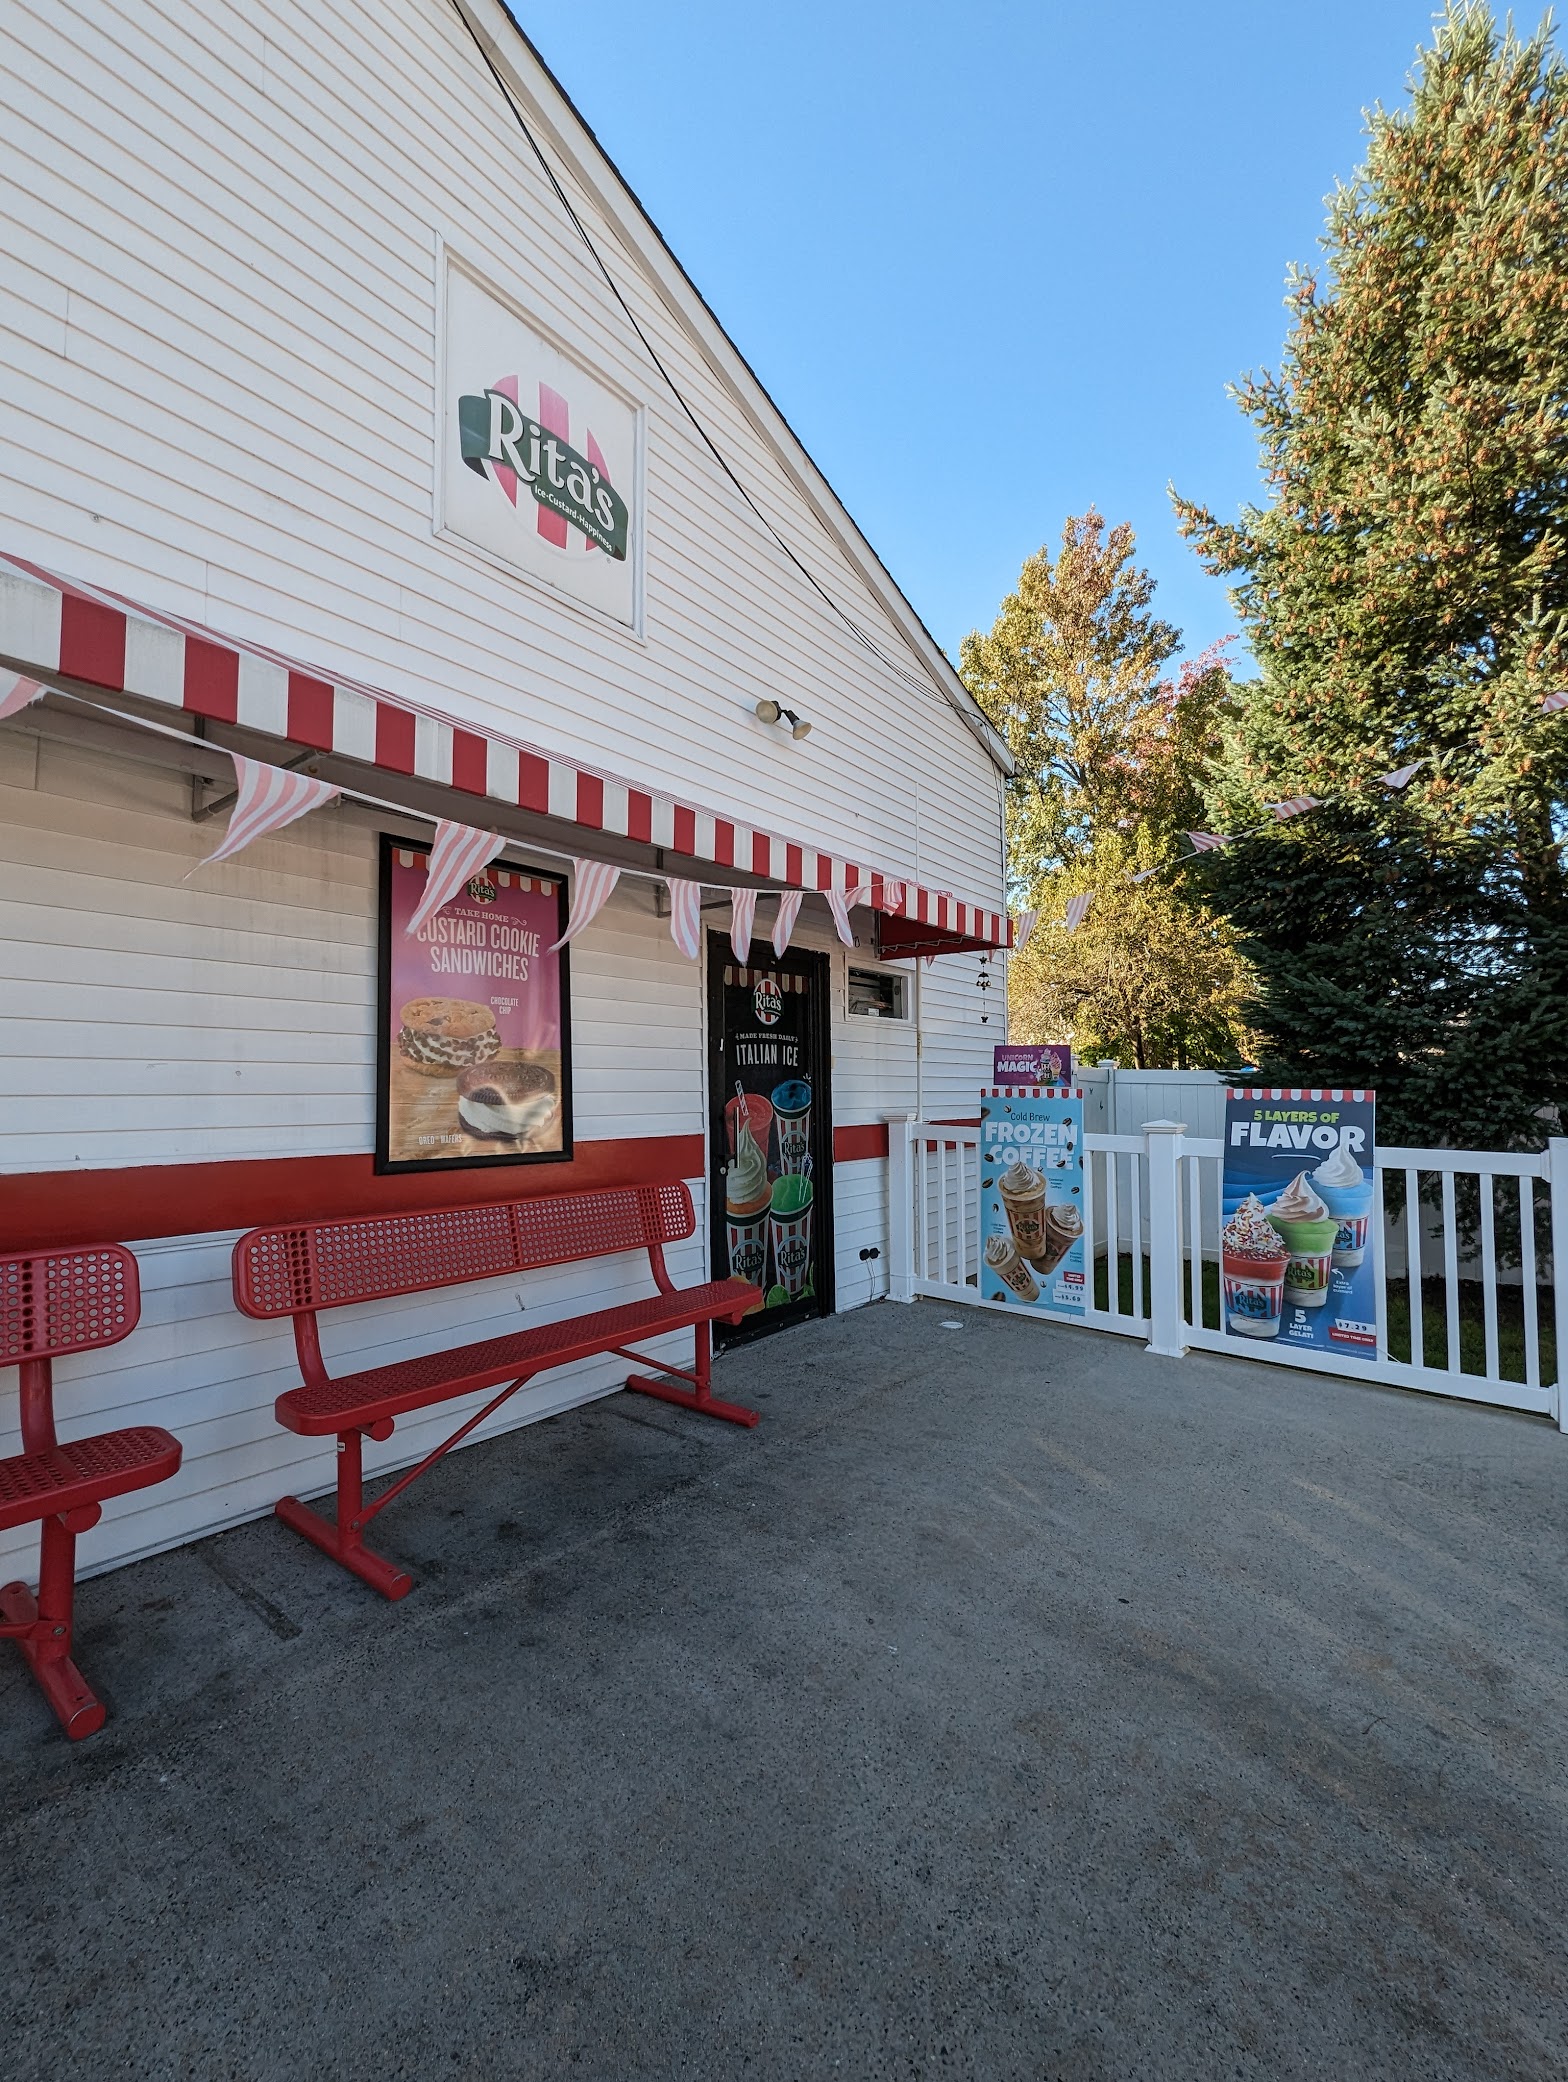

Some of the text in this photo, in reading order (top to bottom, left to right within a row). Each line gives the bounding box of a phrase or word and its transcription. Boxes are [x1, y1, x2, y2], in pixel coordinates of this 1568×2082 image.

[488, 394, 615, 532] Rita's
[470, 882, 495, 898] Rita's
[455, 907, 509, 923] TAKE HOME
[490, 924, 541, 958] COOKIE
[430, 946, 529, 982] SANDWICHES
[490, 996, 519, 1007] CHOCOLATE
[755, 991, 782, 1011] Rita's
[736, 1043, 799, 1067] ITALIAN ICE
[997, 1060, 1039, 1073] MAGIC
[1010, 1112, 1051, 1122] Cold Brew
[1253, 1110, 1340, 1124] 5 LAYERS OF
[985, 1121, 1079, 1147] FROZEN
[1230, 1121, 1366, 1153] FLAVOR
[784, 1141, 805, 1156] Rita's
[989, 1144, 1075, 1171] COFFEE
[735, 1252, 763, 1271] Rita's
[780, 1248, 806, 1266] Rita's
[1287, 1267, 1313, 1278] Rita's
[1294, 1309, 1307, 1323] 5
[1288, 1329, 1314, 1339] GELATI
[1289, 1322, 1313, 1332] LAYER
